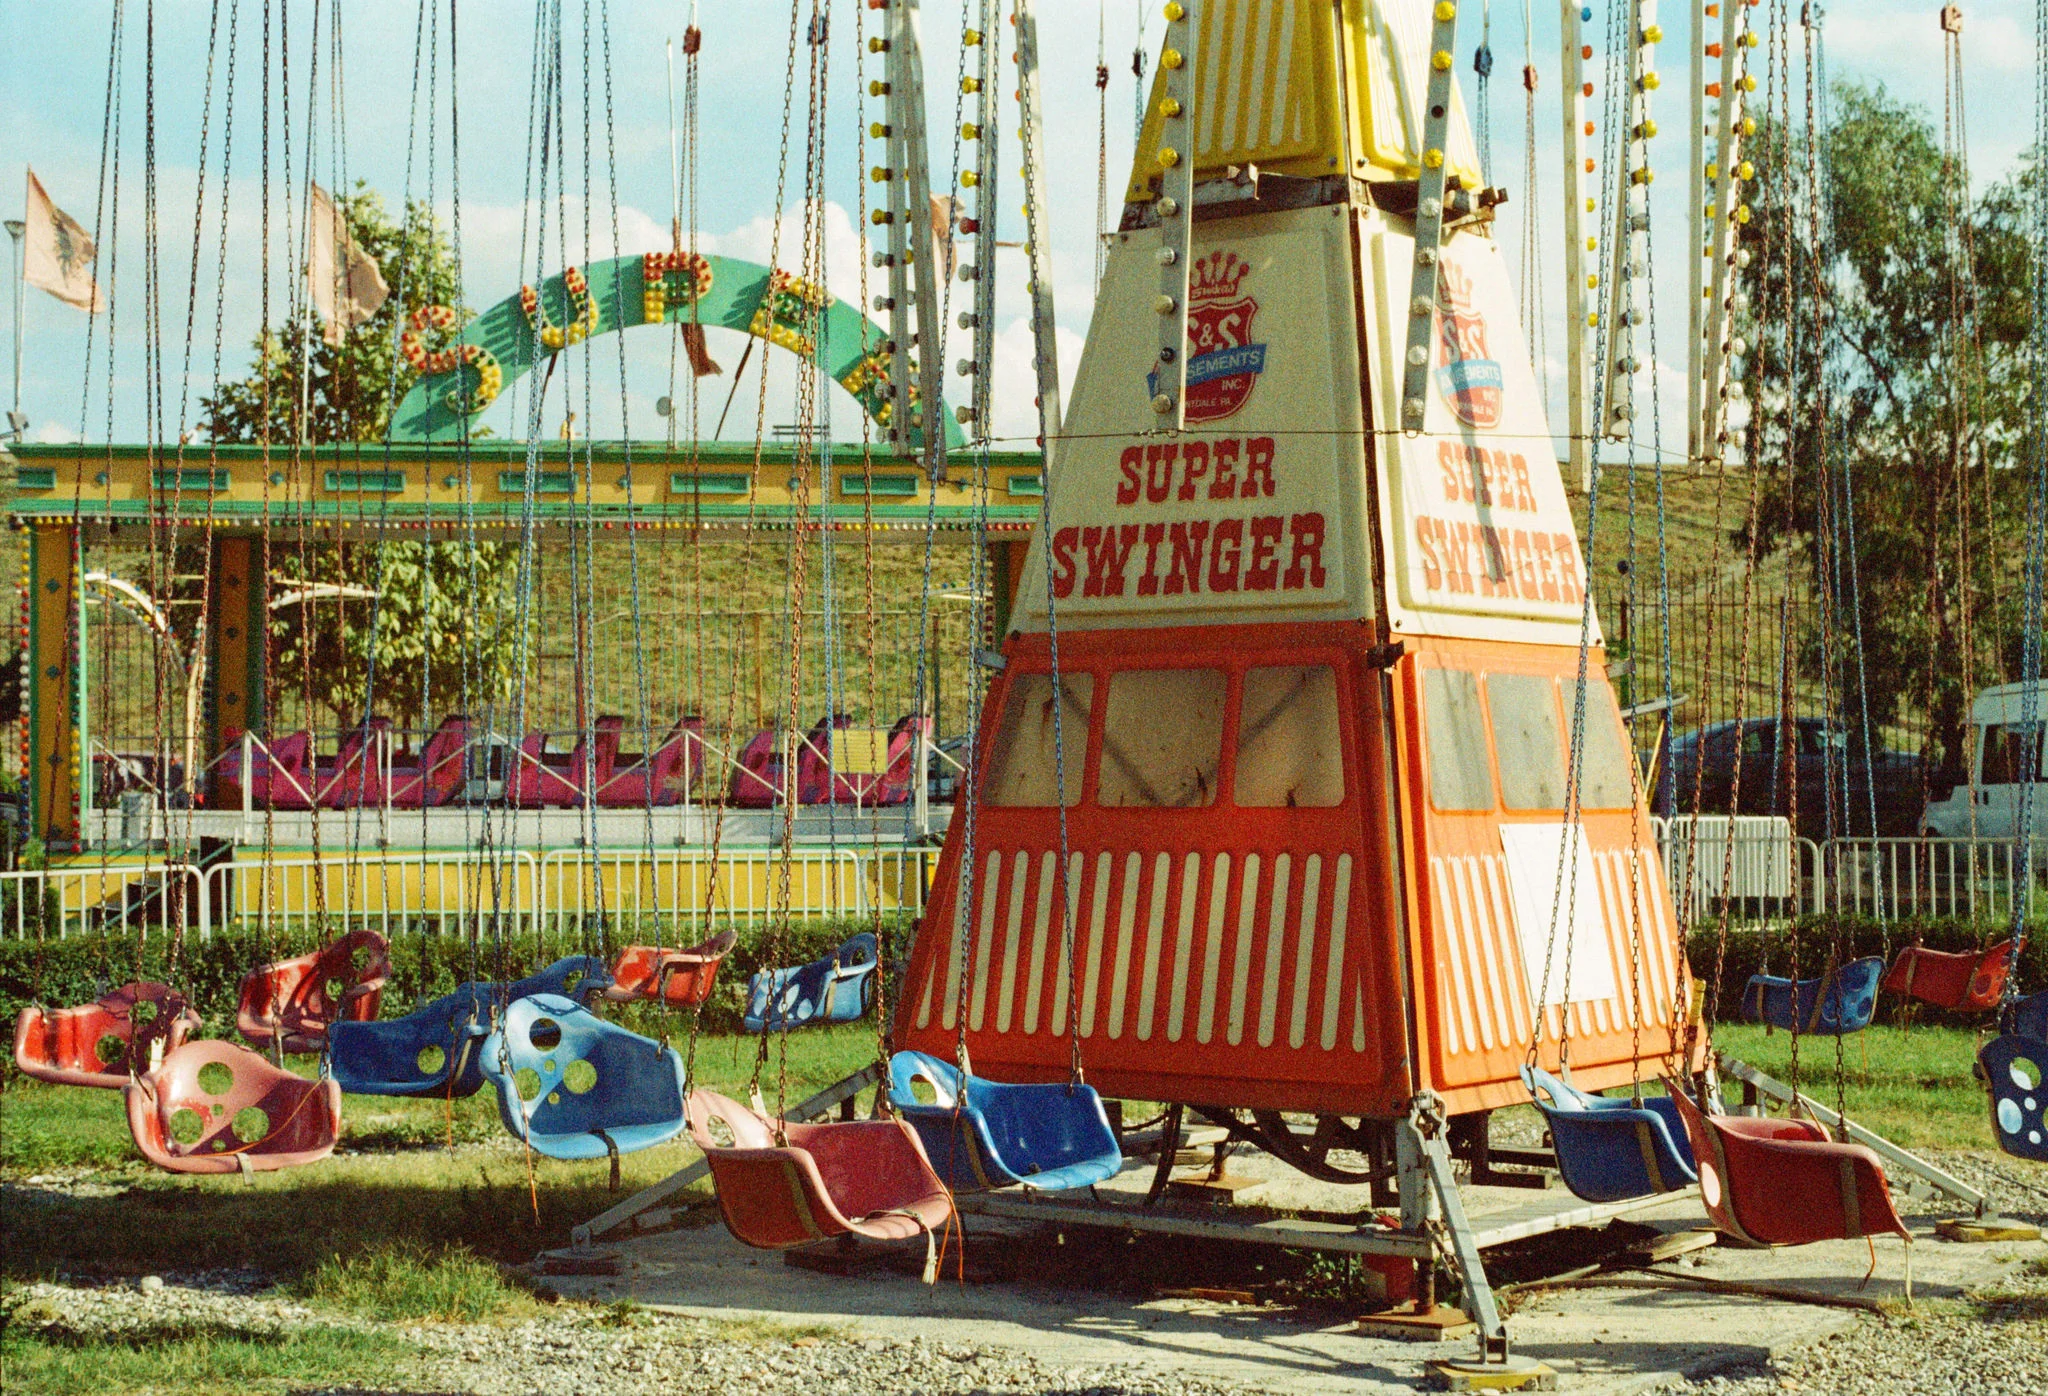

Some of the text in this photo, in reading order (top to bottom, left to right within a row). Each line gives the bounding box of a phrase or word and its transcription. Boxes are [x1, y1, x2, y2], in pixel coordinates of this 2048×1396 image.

[1116, 437, 1276, 505] SUPER
[1438, 440, 1538, 513] SUPER
[1052, 512, 1327, 599] SWINGER
[1416, 515, 1586, 605] SWINGER
